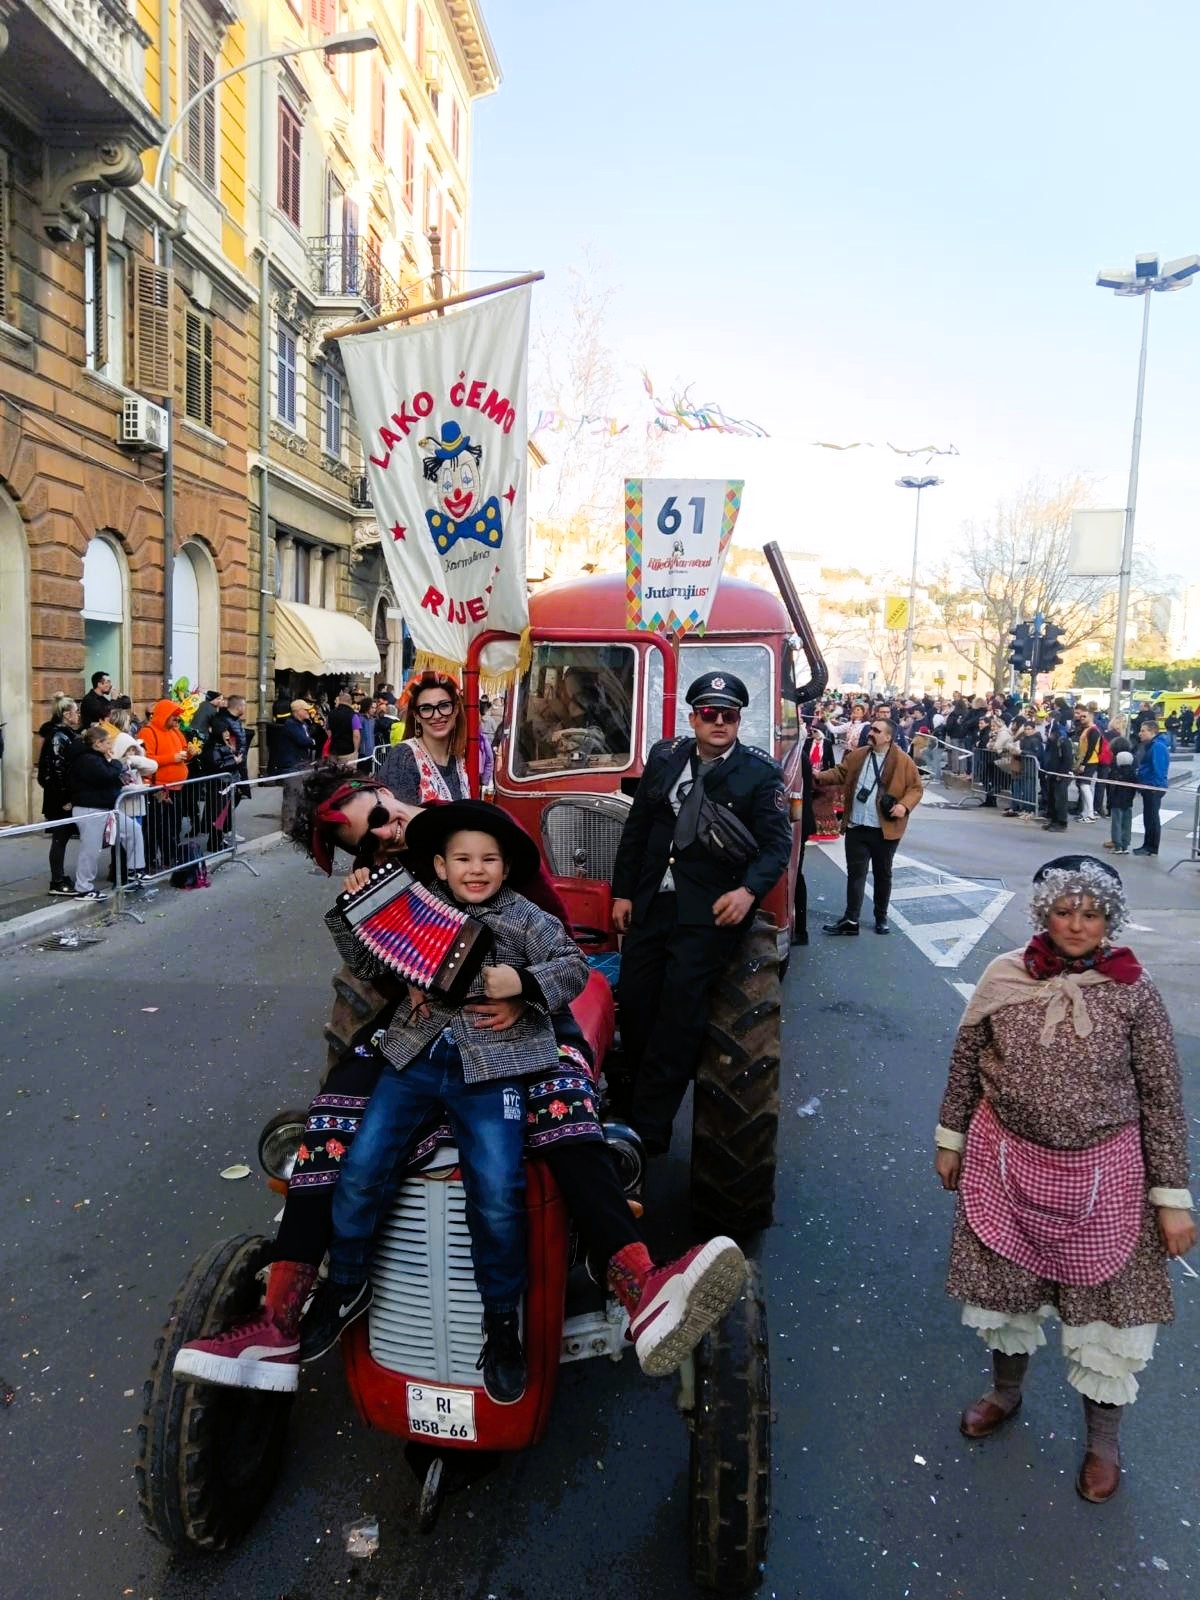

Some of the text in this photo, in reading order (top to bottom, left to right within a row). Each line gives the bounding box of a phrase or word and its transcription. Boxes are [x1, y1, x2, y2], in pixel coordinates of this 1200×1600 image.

[369, 391, 434, 470] LAKO
[657, 496, 706, 535] 61
[503, 1093, 521, 1107] NYC
[412, 1388, 423, 1401] 3
[436, 1397, 451, 1414] RI
[412, 1419, 468, 1438] 858-66
